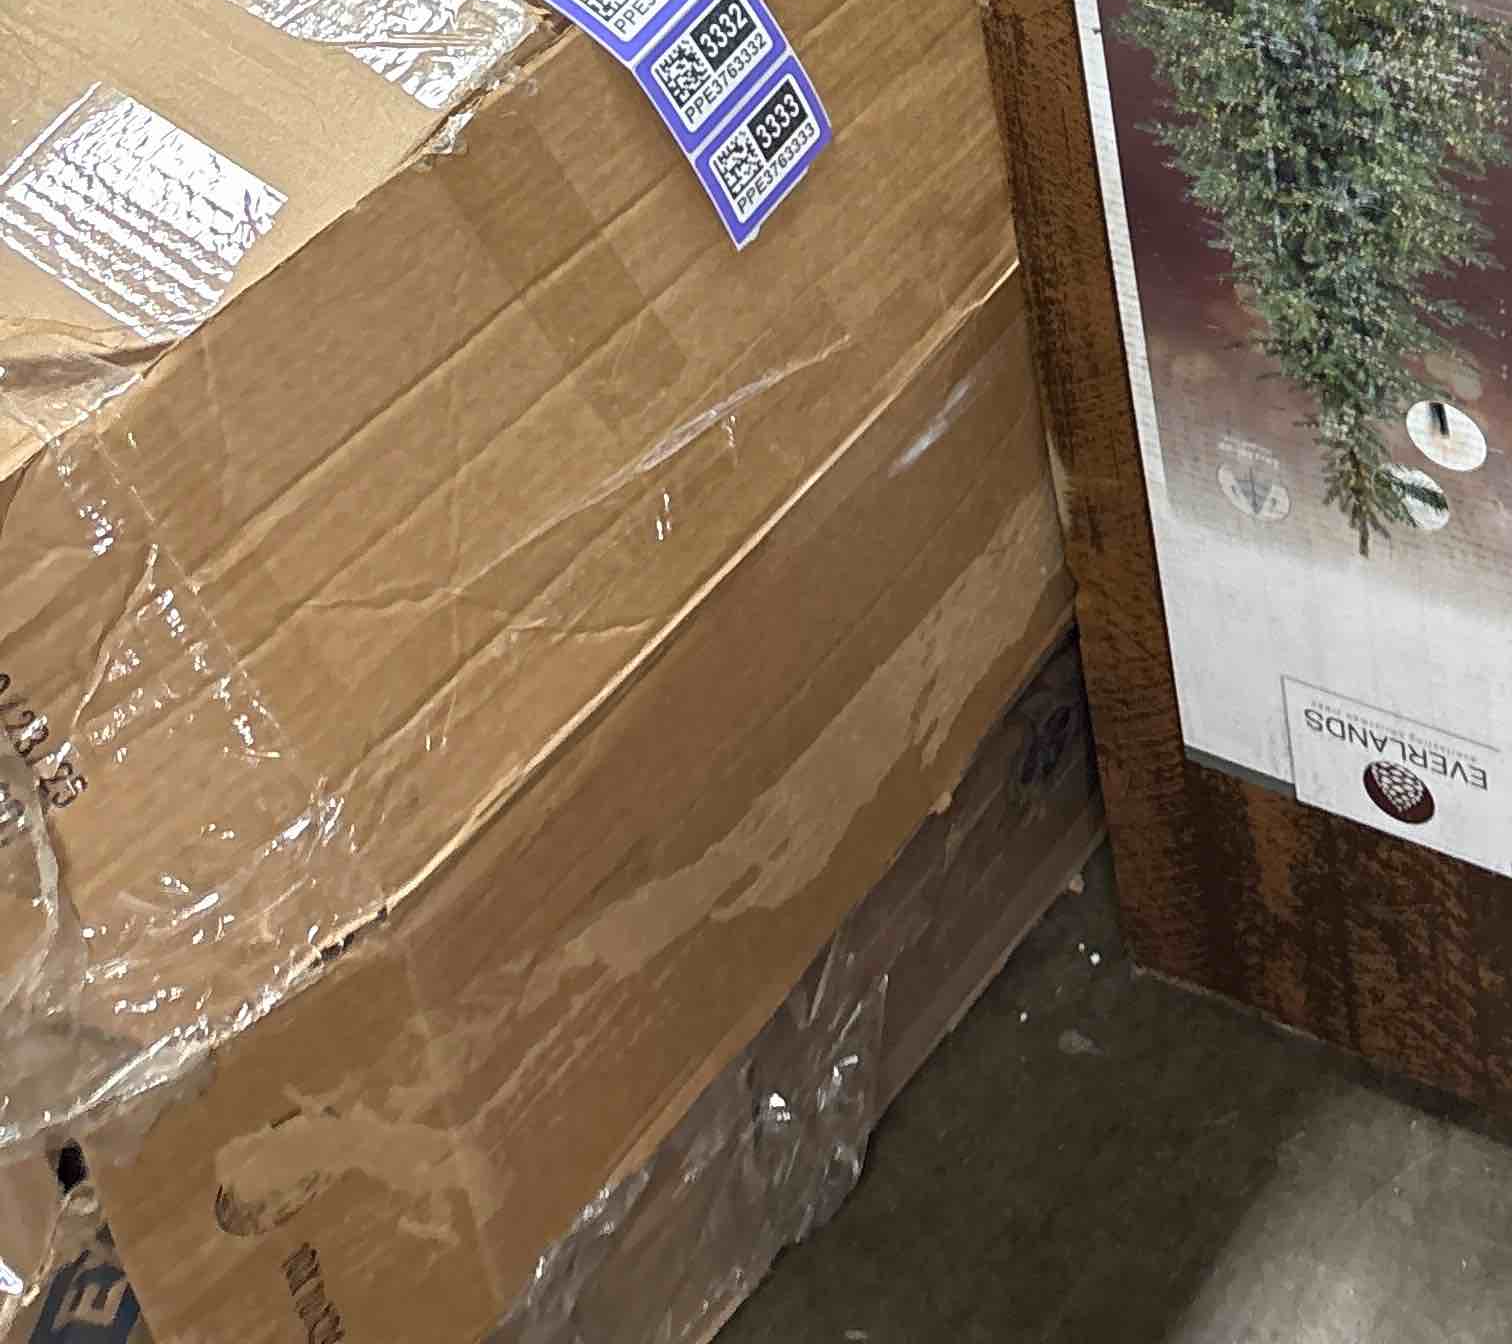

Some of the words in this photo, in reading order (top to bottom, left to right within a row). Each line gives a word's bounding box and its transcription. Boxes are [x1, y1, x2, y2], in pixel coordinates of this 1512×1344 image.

[698, 1, 749, 58] 3332
[684, 31, 770, 125] PPE3763332
[754, 92, 801, 149] 3333
[736, 121, 817, 214] PPE3763333
[1303, 707, 1489, 791] EVERLANDS
